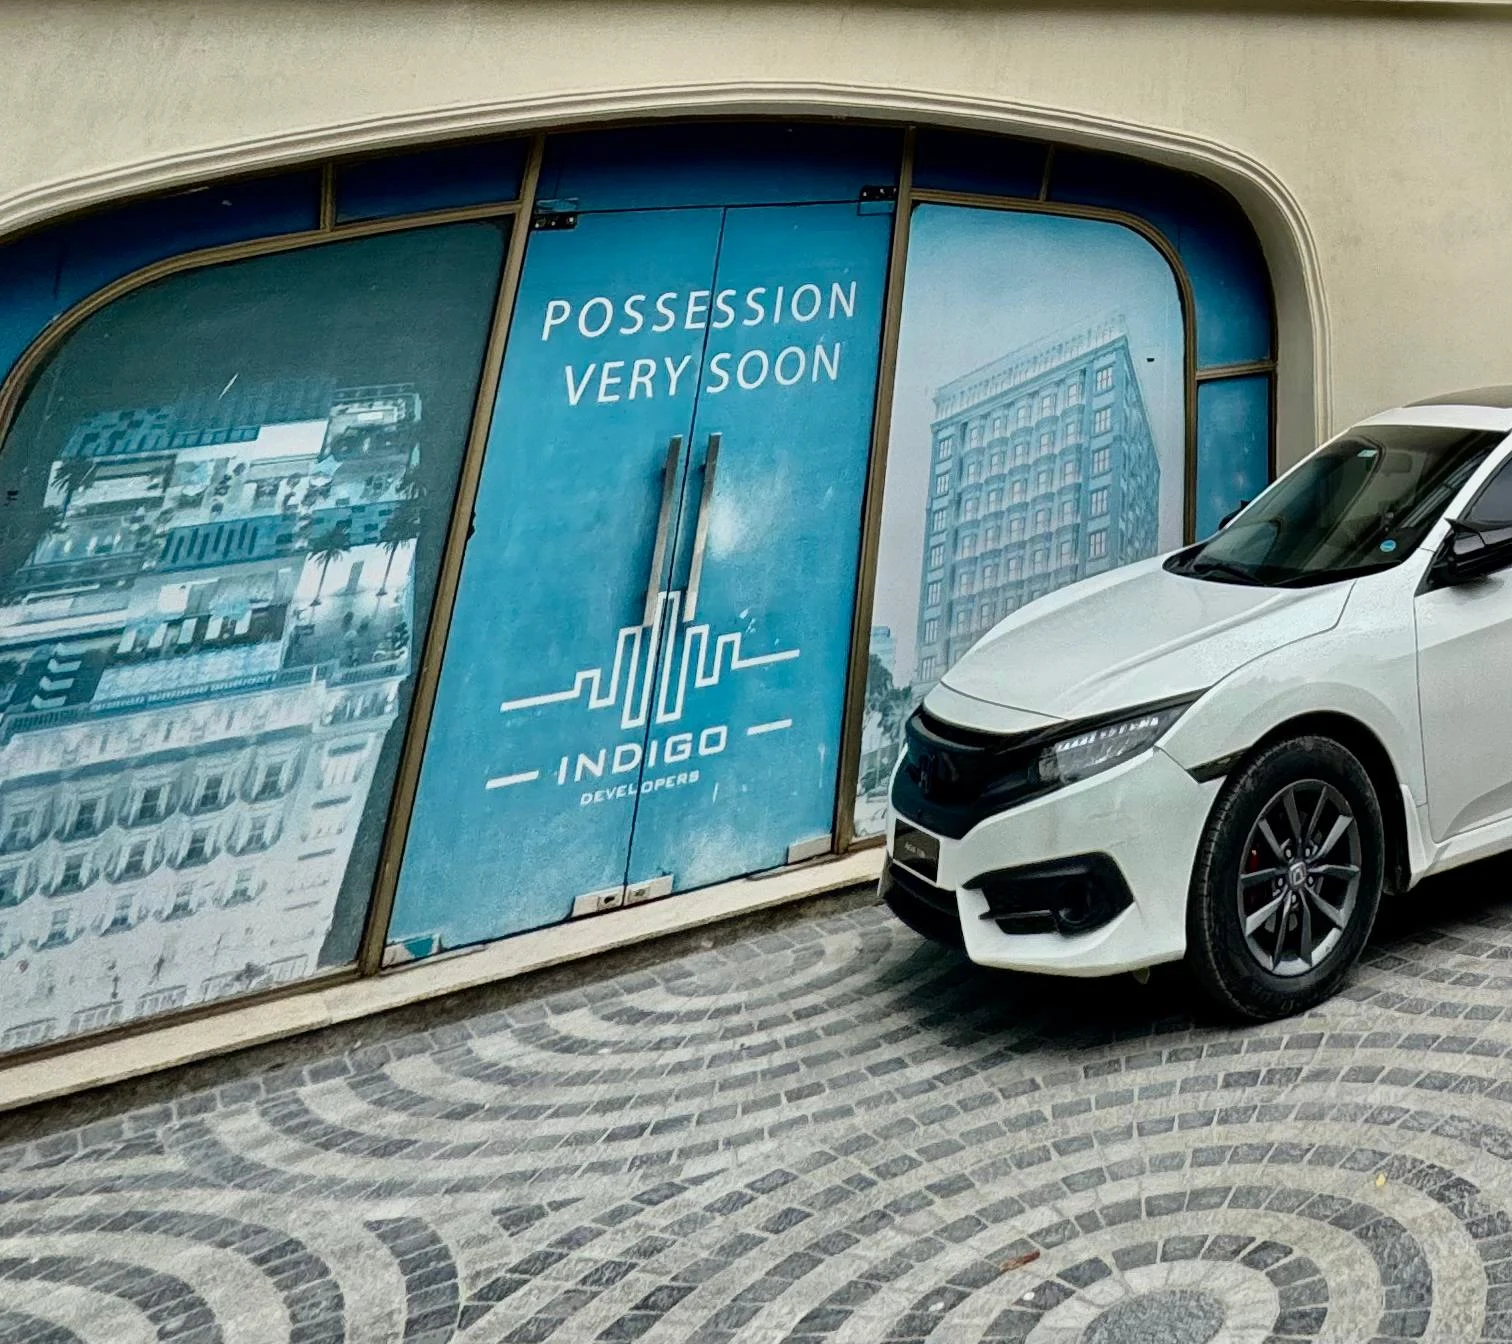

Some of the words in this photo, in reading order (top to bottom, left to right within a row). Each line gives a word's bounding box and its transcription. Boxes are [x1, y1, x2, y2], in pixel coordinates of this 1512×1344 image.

[541, 281, 857, 341] POSSESSION
[565, 354, 691, 406] VERY
[706, 342, 841, 393] SOON
[556, 725, 728, 785] INDIGO
[579, 770, 700, 806] DEVELOPERS
